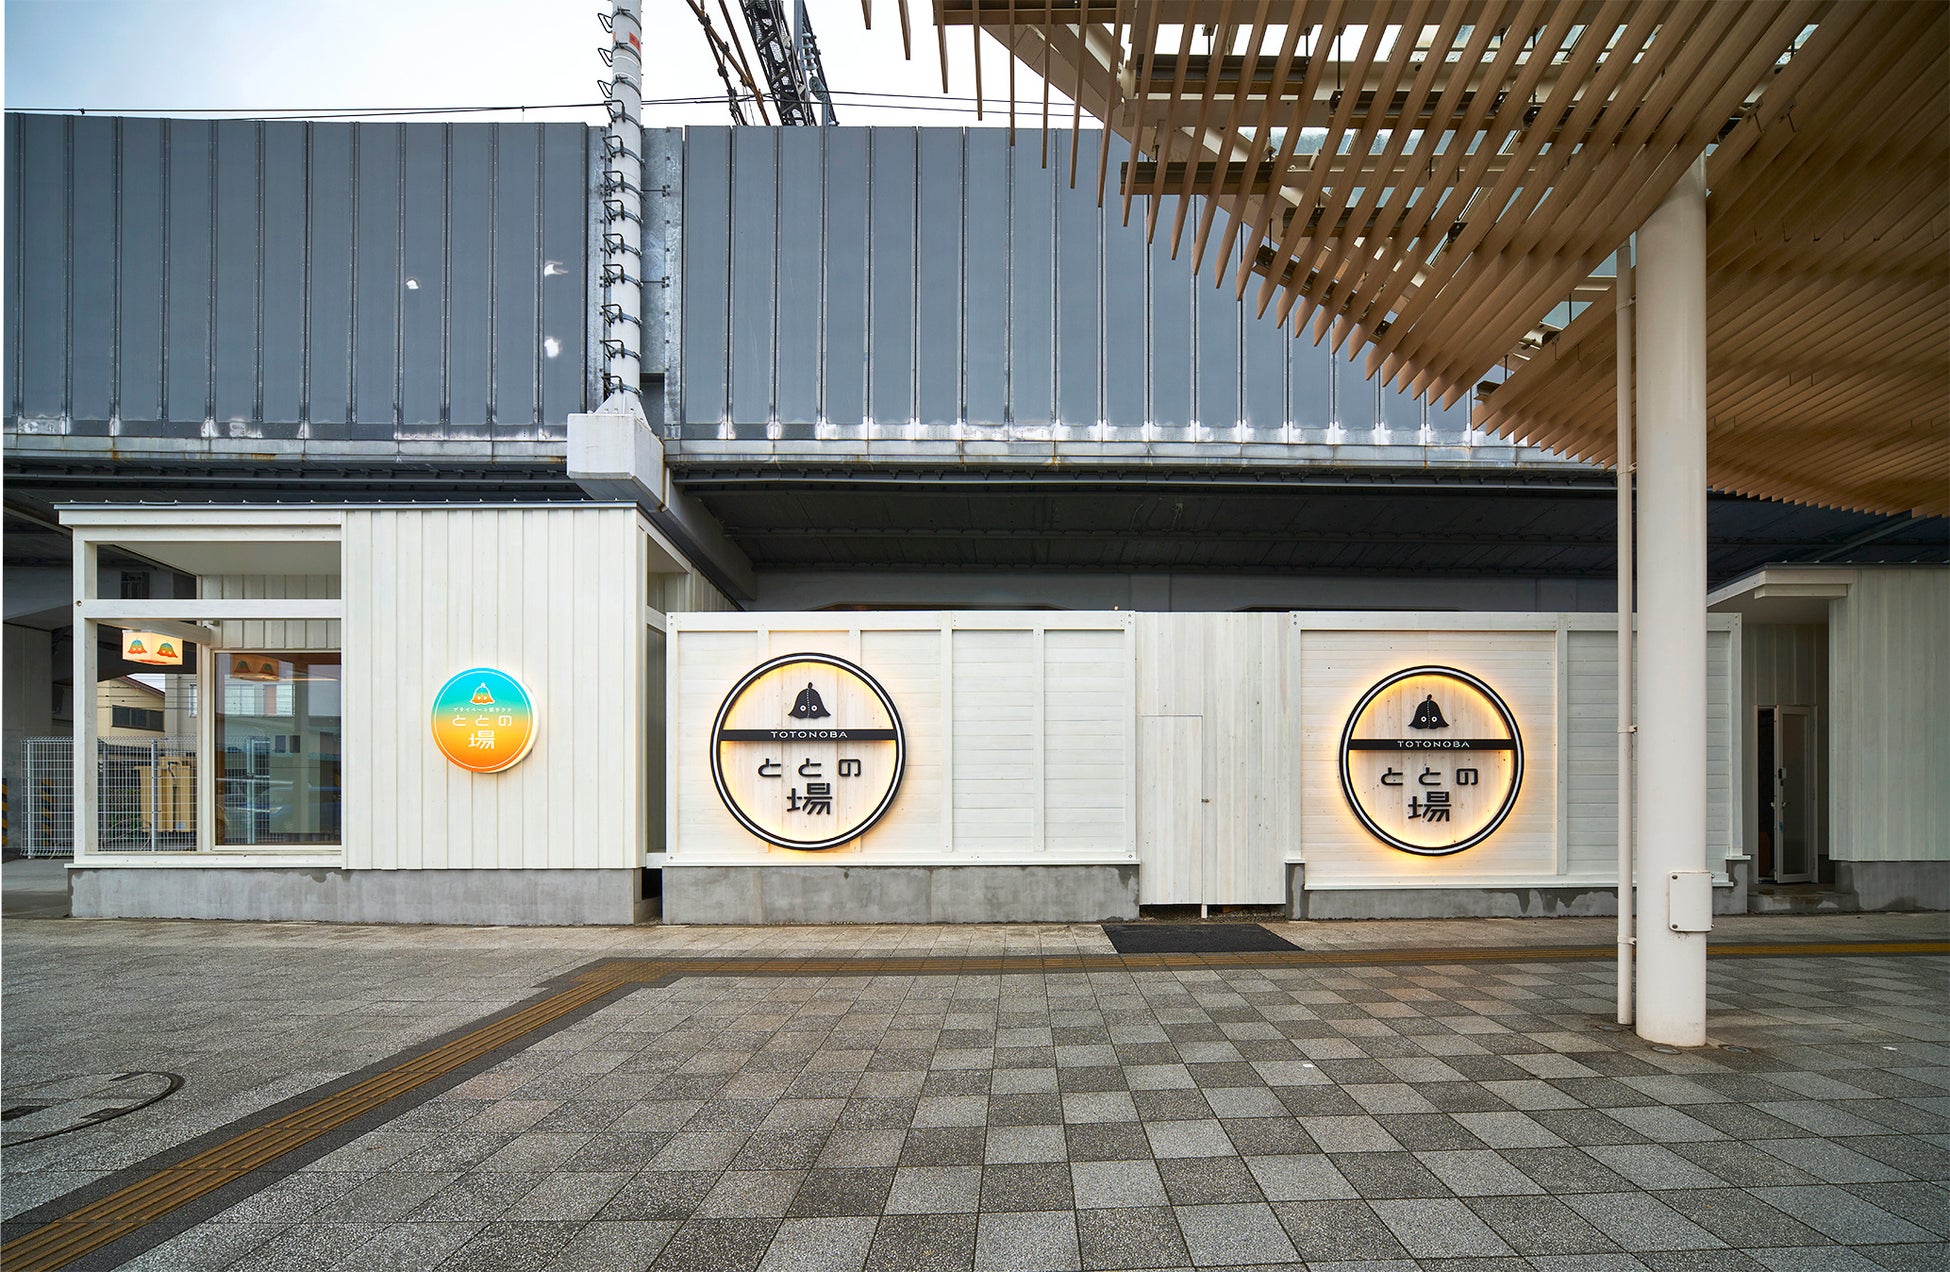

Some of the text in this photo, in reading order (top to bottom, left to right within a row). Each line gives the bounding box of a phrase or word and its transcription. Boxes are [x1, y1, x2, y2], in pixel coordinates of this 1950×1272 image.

[452, 714, 512, 727] ととの
[468, 729, 496, 750] 場
[770, 730, 848, 739] TOTONOBA
[1397, 740, 1470, 748] TOTONOBA
[757, 757, 862, 778] ととの
[1380, 766, 1479, 787] ととの
[786, 782, 833, 815] 場
[1407, 791, 1452, 822] 場
